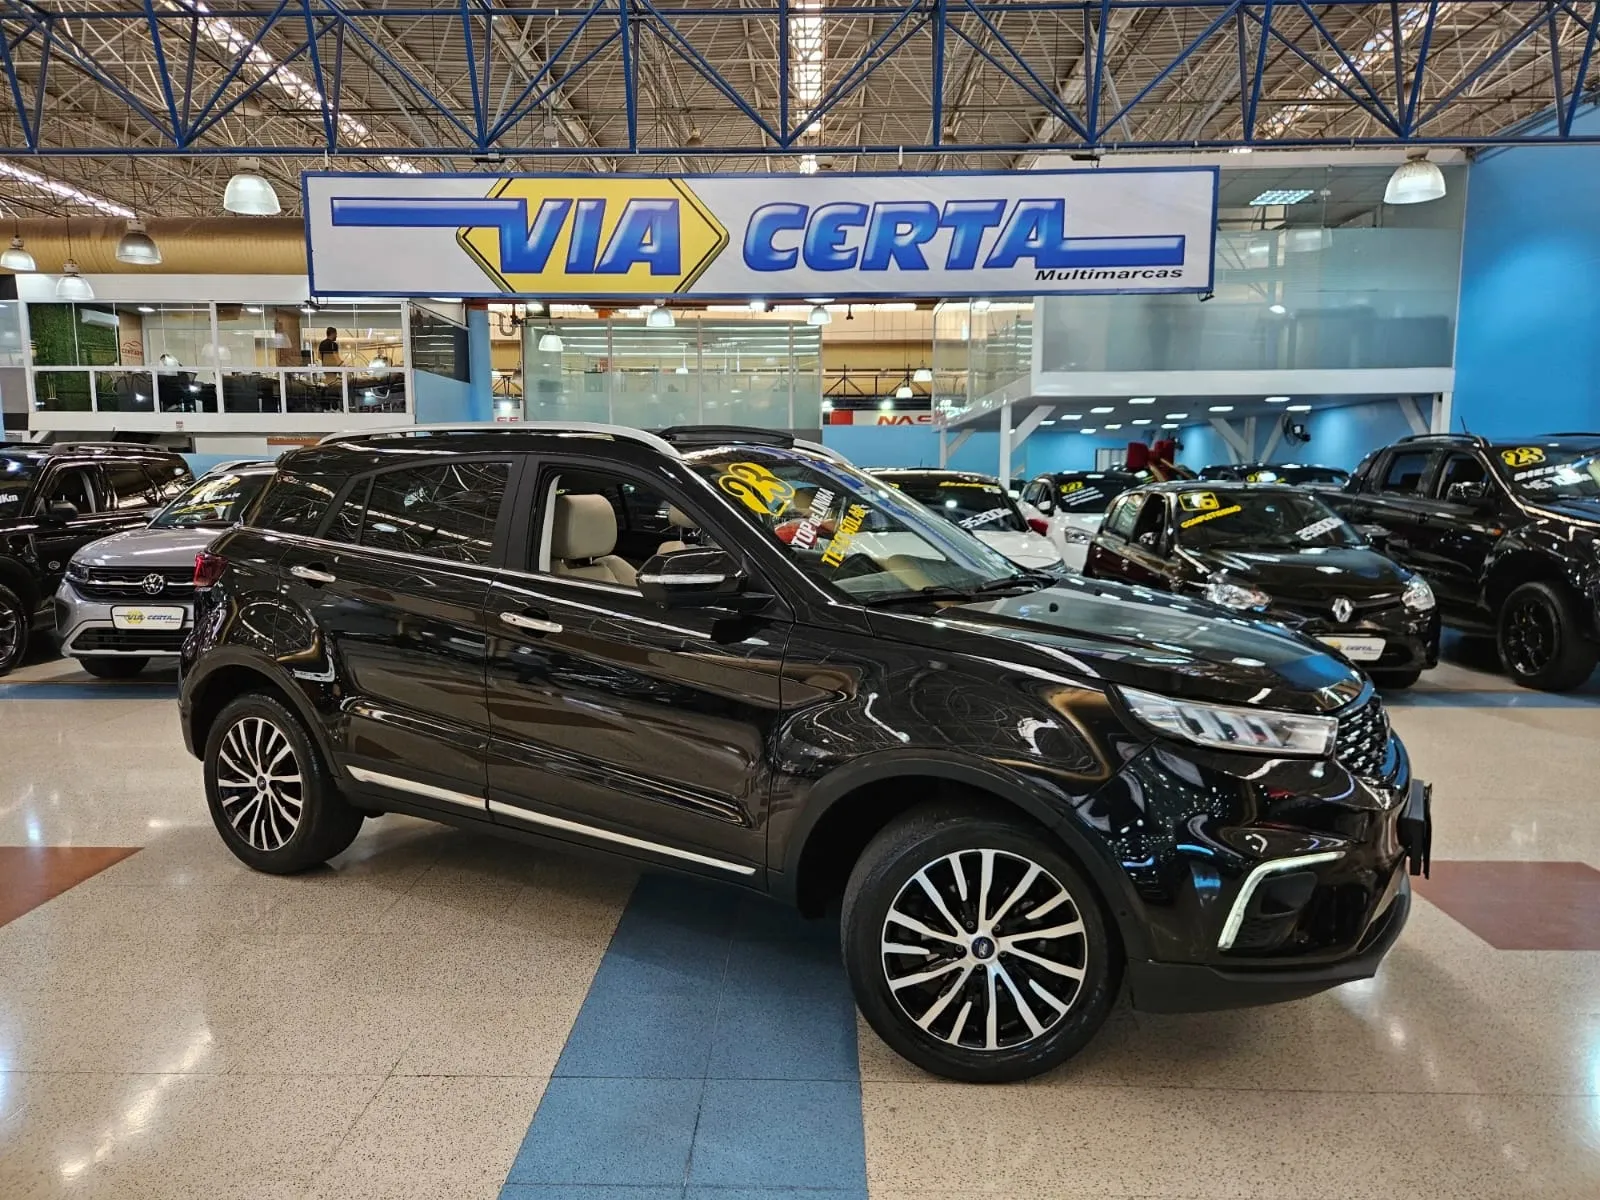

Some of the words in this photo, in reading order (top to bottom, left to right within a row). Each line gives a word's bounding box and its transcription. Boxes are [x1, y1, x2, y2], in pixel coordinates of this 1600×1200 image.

[498, 198, 682, 276] VIA
[742, 198, 1068, 272] CERTA
[1035, 268, 1183, 281] Multimarcas
[1501, 447, 1546, 467] 23
[719, 462, 795, 516] 23
[809, 487, 835, 521] LINHA
[808, 511, 823, 528] DE
[791, 520, 817, 549] TOP
